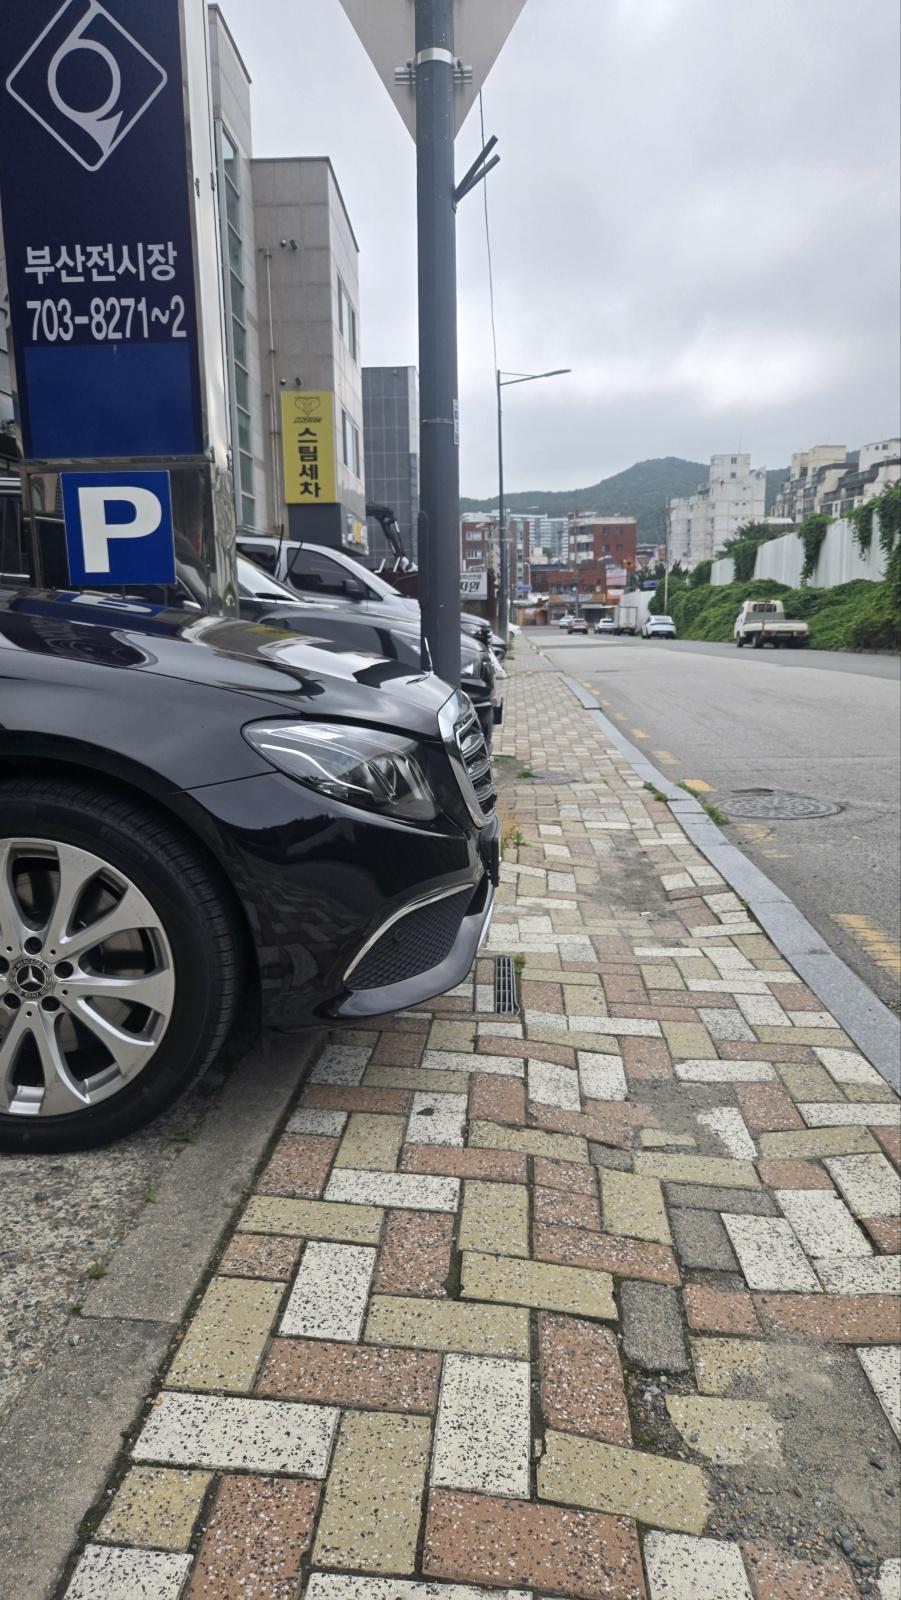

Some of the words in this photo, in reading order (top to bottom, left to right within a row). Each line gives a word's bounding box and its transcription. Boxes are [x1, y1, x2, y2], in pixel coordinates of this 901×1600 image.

[25, 241, 178, 285] 부산전시장
[26, 295, 187, 341] 703-8271~2
[298, 427, 321, 498] 스팀세차
[78, 486, 162, 573] P
